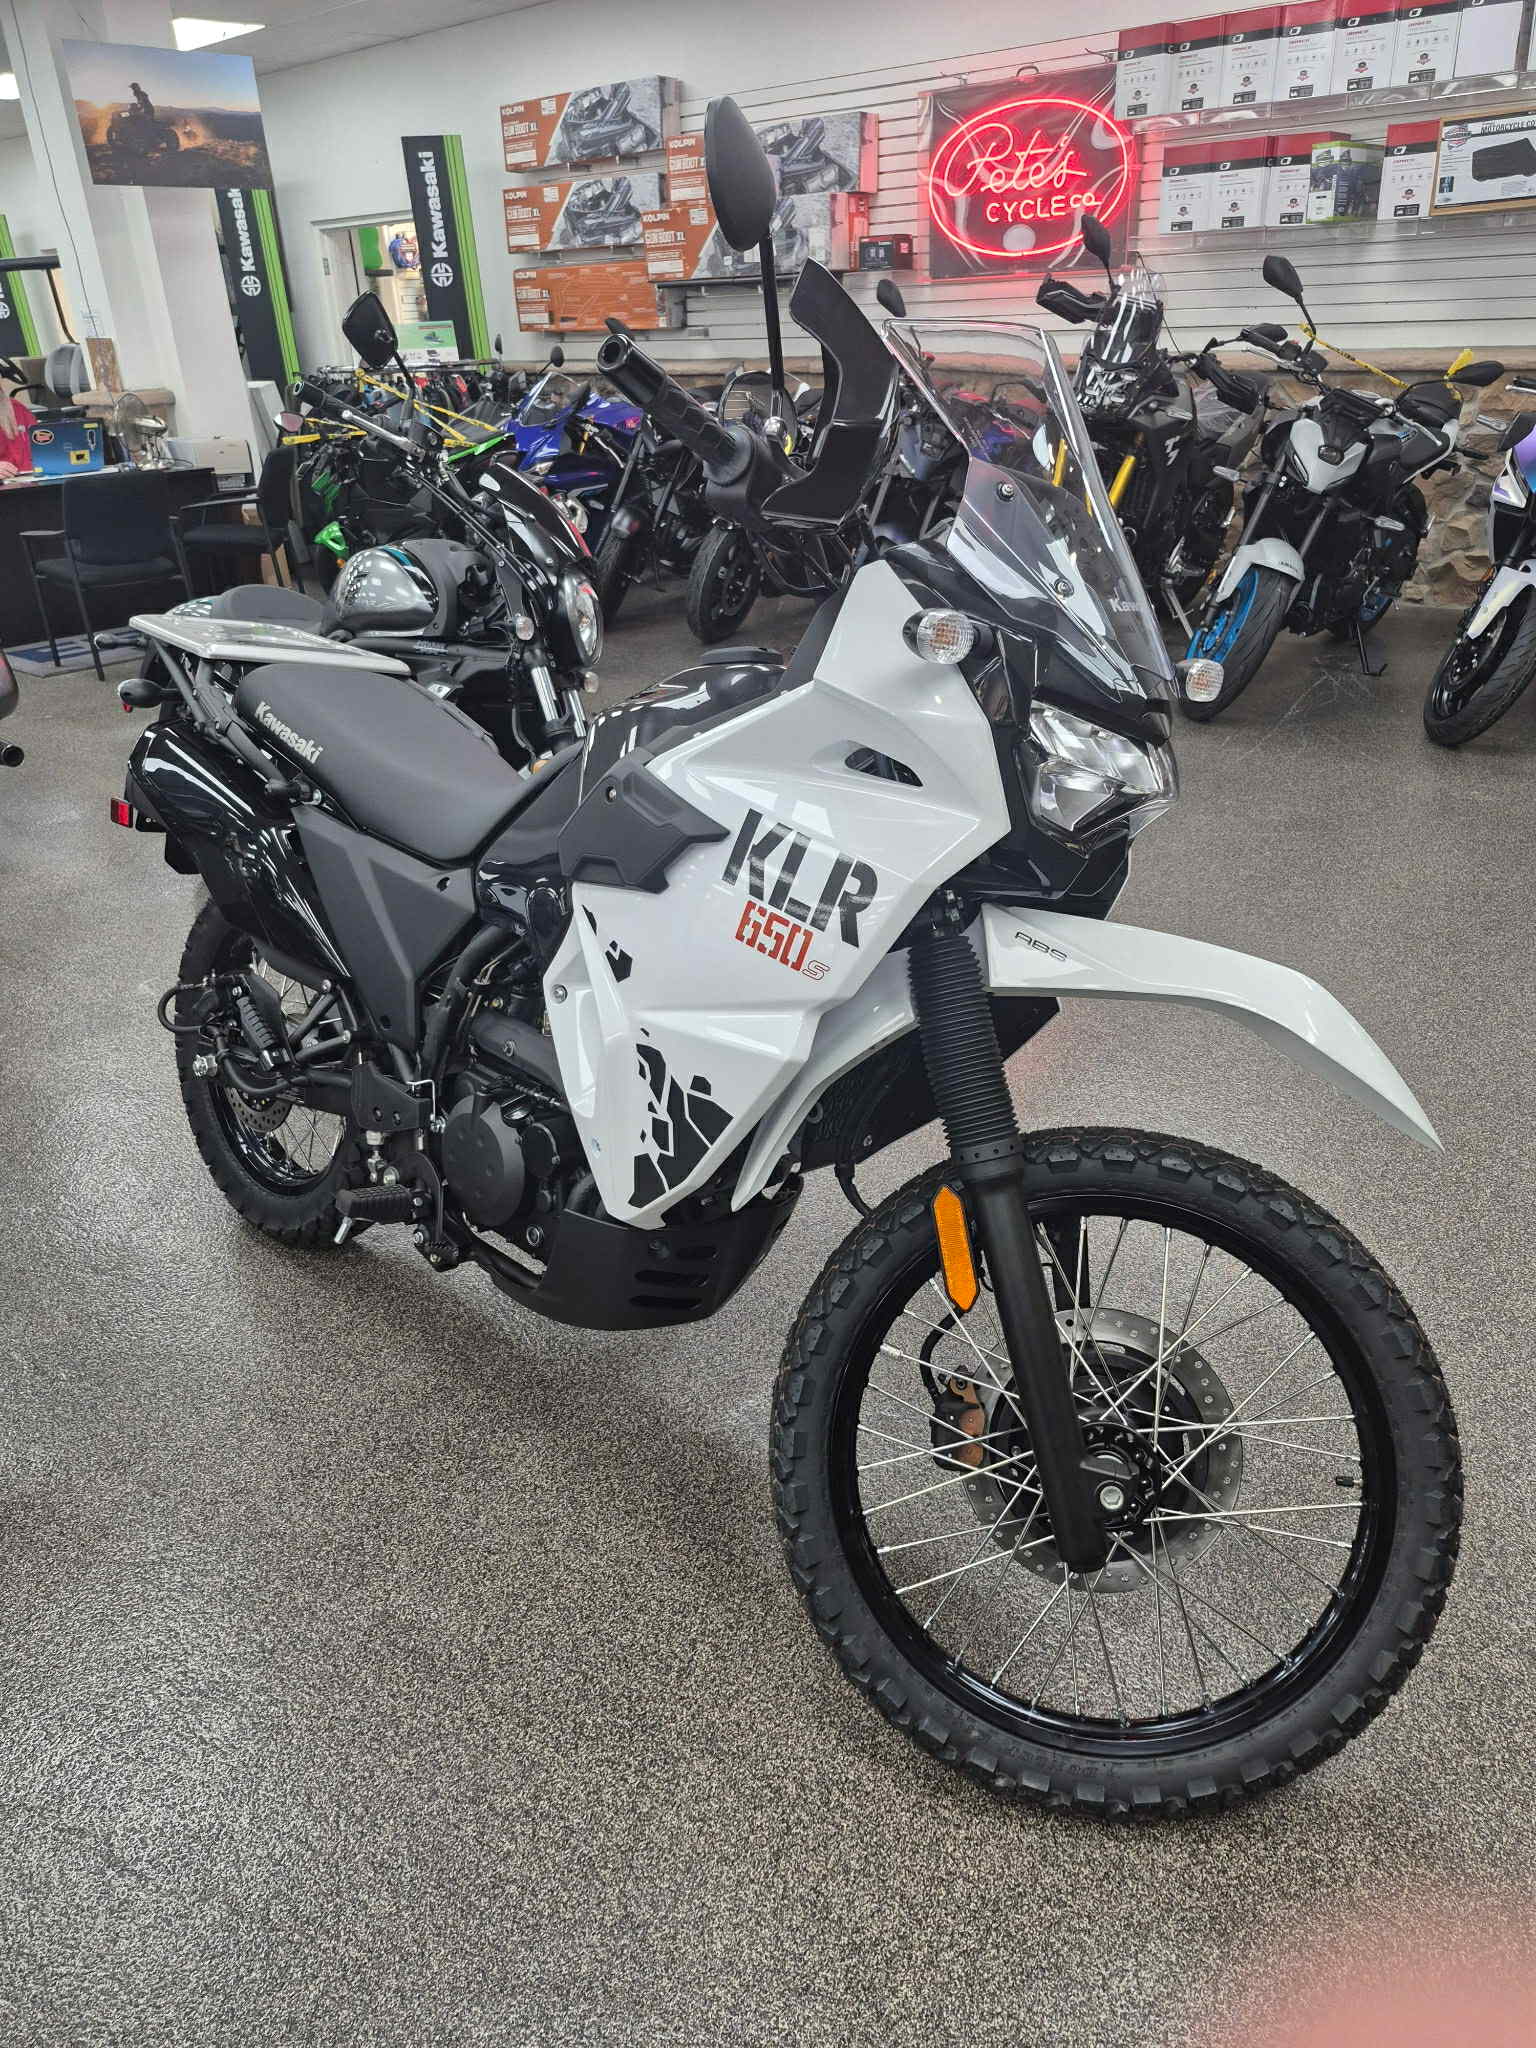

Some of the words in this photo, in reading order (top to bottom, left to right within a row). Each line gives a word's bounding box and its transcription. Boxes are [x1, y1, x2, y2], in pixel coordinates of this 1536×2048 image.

[227, 188, 256, 272] Kawasak
[418, 151, 449, 258] Kawasaki
[986, 196, 1067, 223] CYCLE
[254, 701, 324, 764] Kawasaki
[721, 807, 879, 949] KLR
[1014, 931, 1068, 962] ABS
